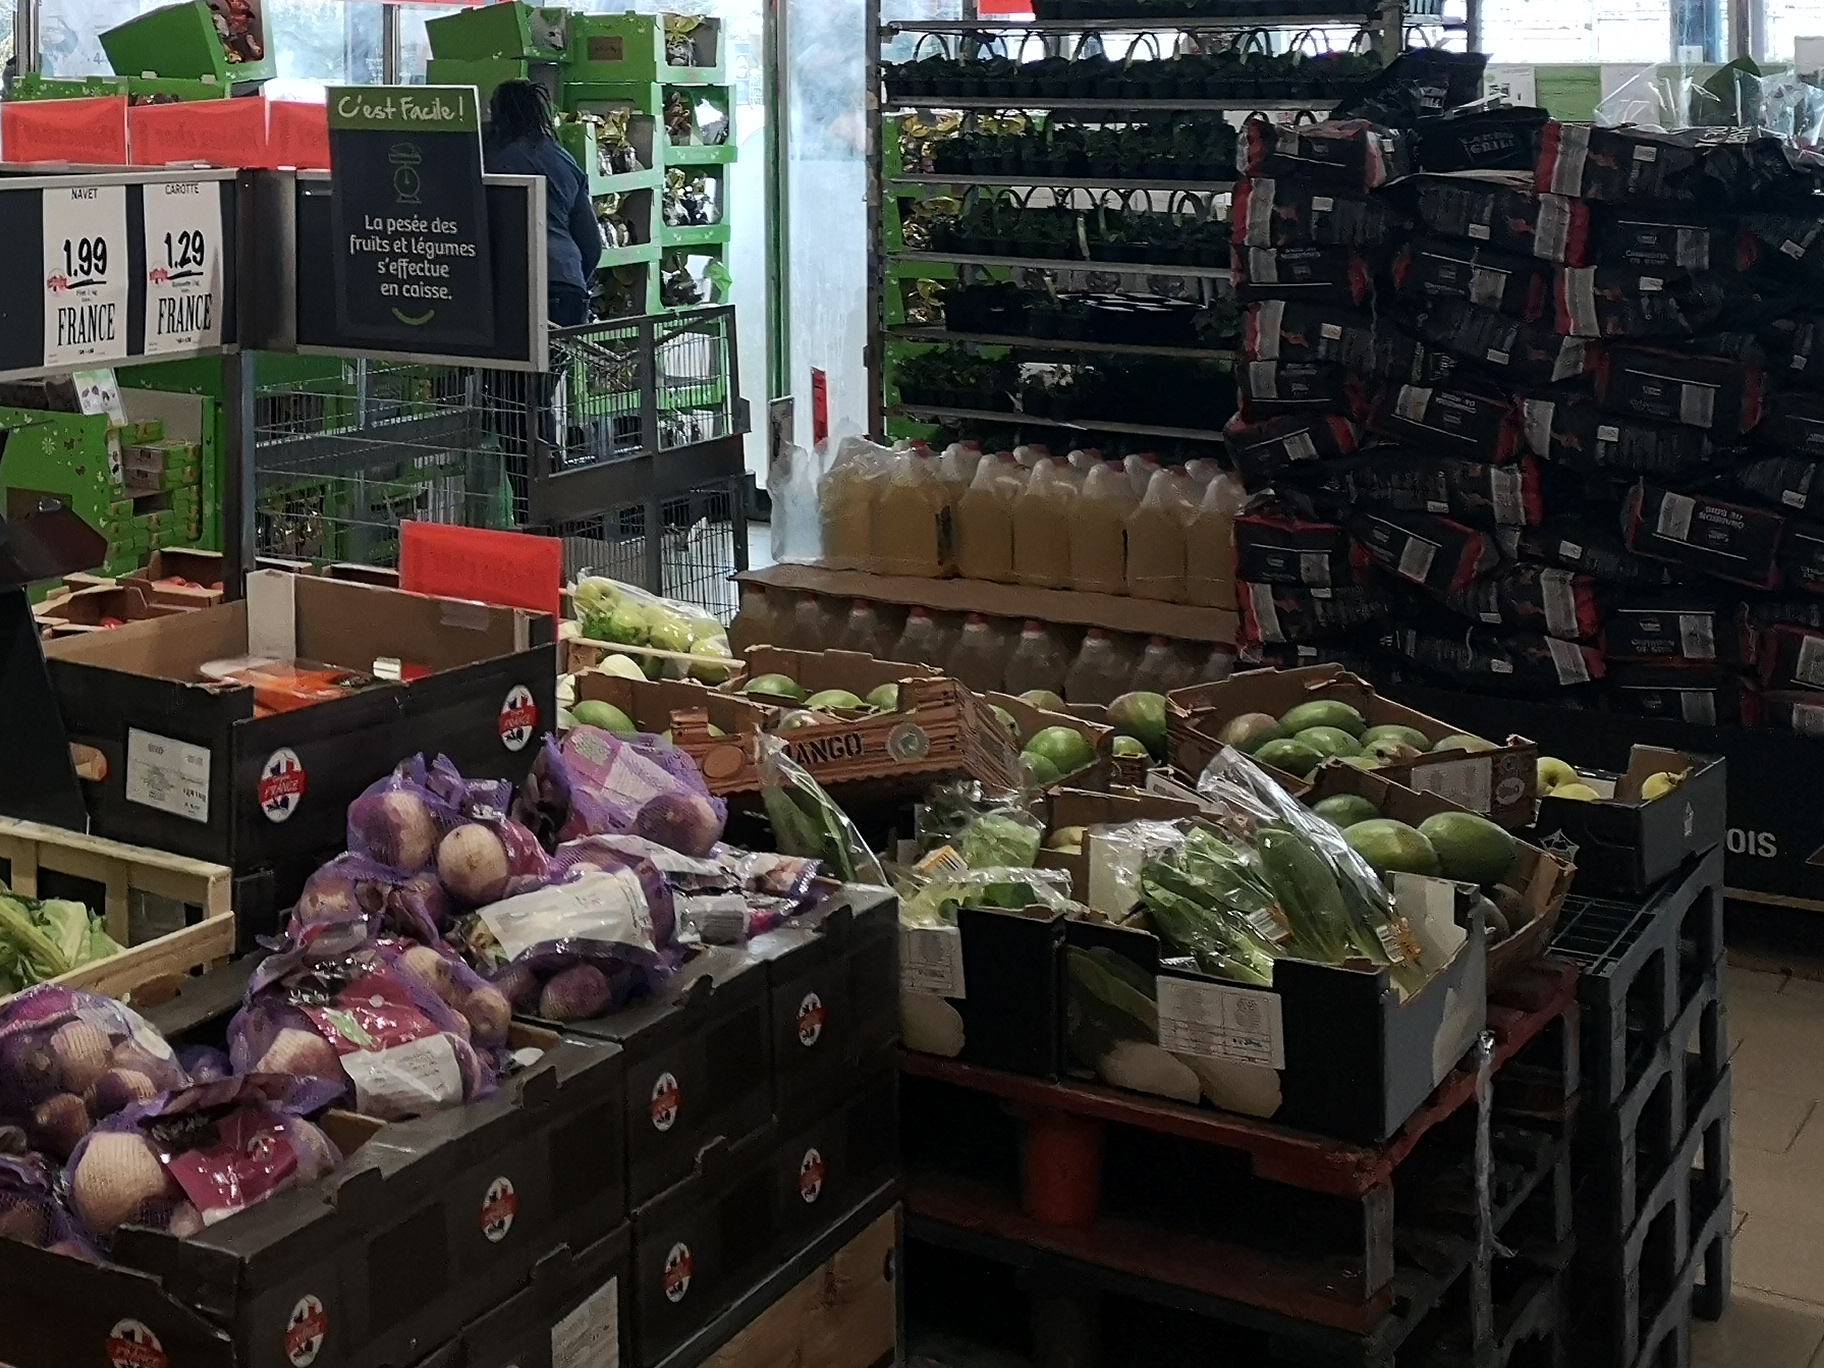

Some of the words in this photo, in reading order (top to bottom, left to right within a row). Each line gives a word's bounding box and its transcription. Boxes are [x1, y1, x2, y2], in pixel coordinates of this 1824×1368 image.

[337, 94, 397, 120] C'est
[71, 188, 98, 200] NAVET
[165, 182, 200, 195] CAROTTE
[364, 214, 384, 231] La
[386, 214, 429, 234] pesée
[431, 216, 458, 234] des
[63, 236, 107, 277] 1.99
[164, 230, 205, 269] 1.29
[349, 234, 391, 255] fruits
[393, 236, 409, 254] et
[411, 236, 476, 259] légumes
[377, 257, 450, 280] s'effectue
[380, 282, 399, 297] en
[402, 282, 453, 300] caisse.
[57, 303, 116, 348] FRANCE
[157, 293, 213, 336] FRANCE
[1726, 828, 1777, 859] OIS
